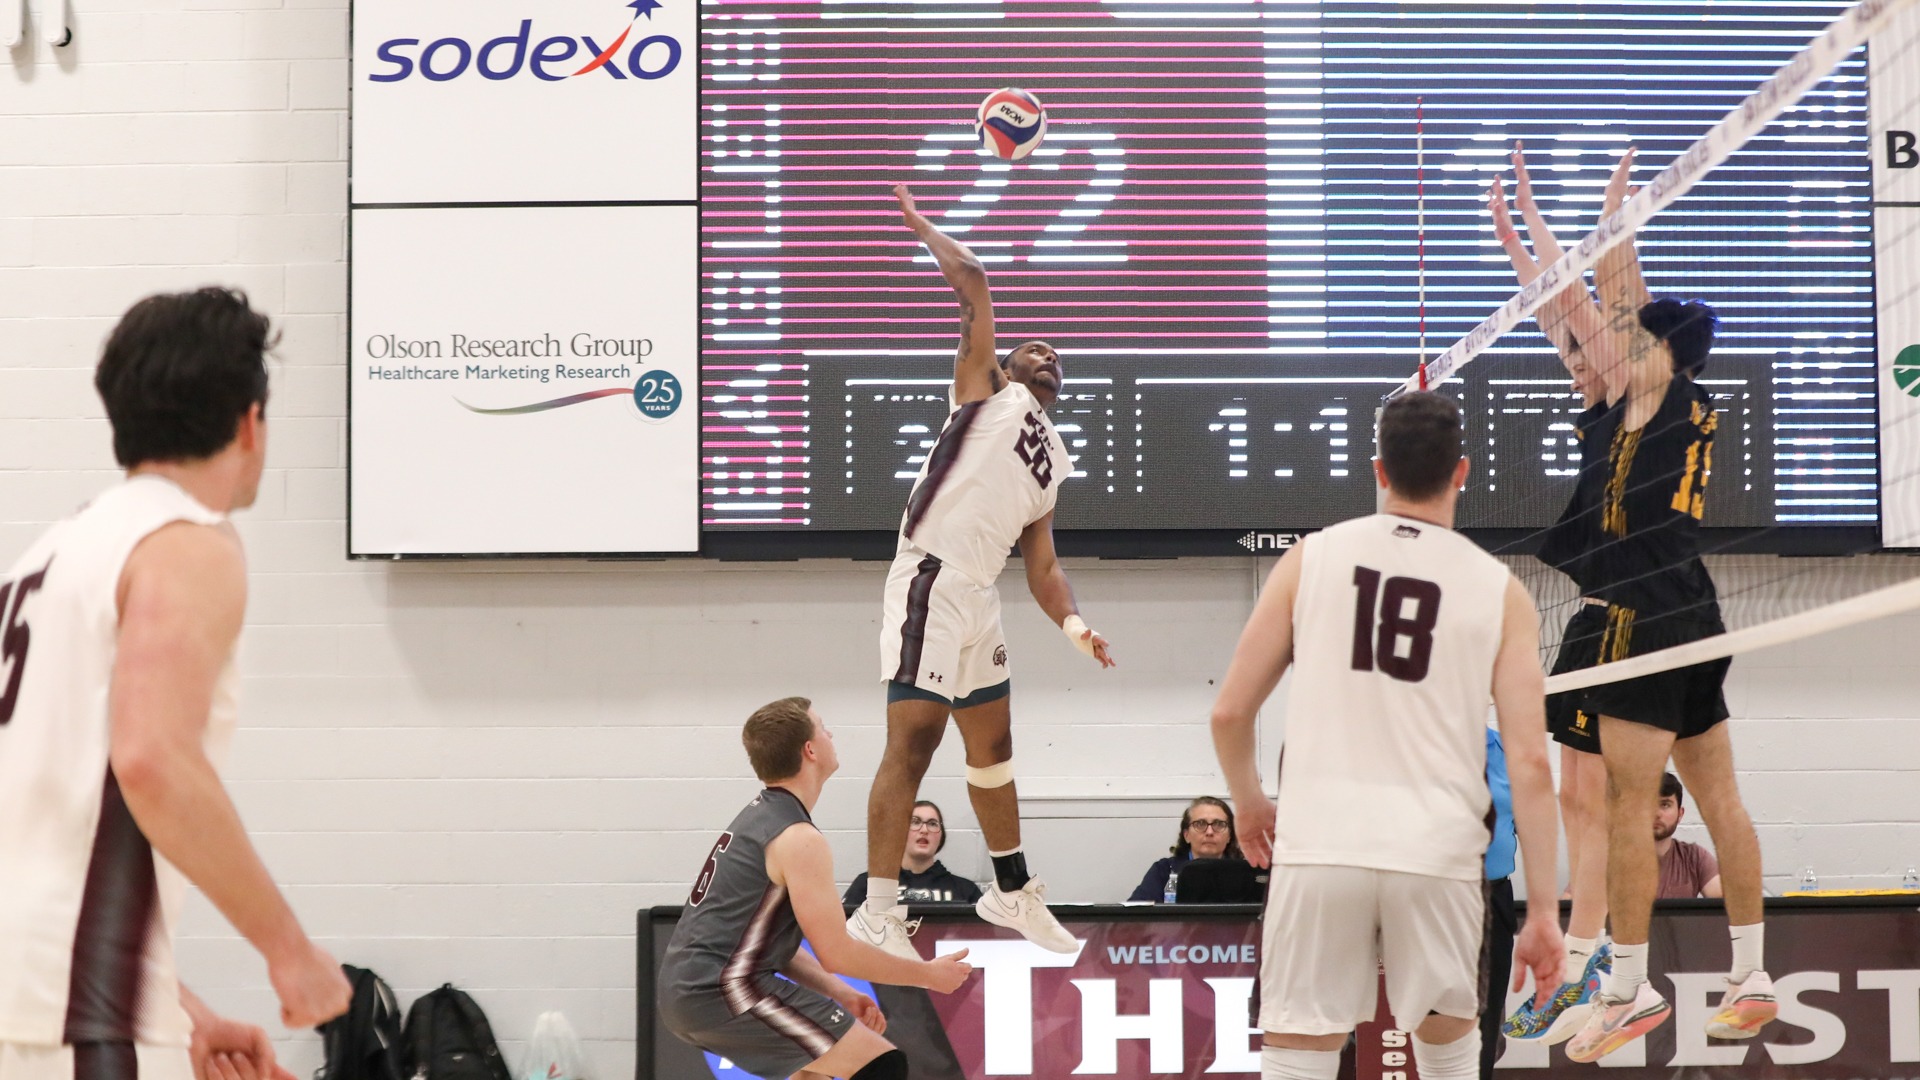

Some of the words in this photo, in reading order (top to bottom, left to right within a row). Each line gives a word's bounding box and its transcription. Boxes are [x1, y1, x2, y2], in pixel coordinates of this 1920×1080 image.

[368, 19, 682, 83] sodexo
[1000, 105, 1024, 124] NCAA
[911, 122, 1128, 263] 22
[711, 14, 783, 523] EAGLES
[366, 334, 443, 359] Olson
[450, 332, 563, 358] Research
[570, 332, 653, 364] Group
[368, 365, 460, 381] Healthcare
[465, 365, 550, 383] Marketing
[555, 364, 631, 379] Research
[641, 378, 675, 403] 25
[1014, 411, 1053, 490] 20
[1350, 565, 1442, 683] 18
[689, 831, 733, 907] 6
[1107, 945, 1256, 964] WELCOME
[935, 939, 1263, 1075] THE
